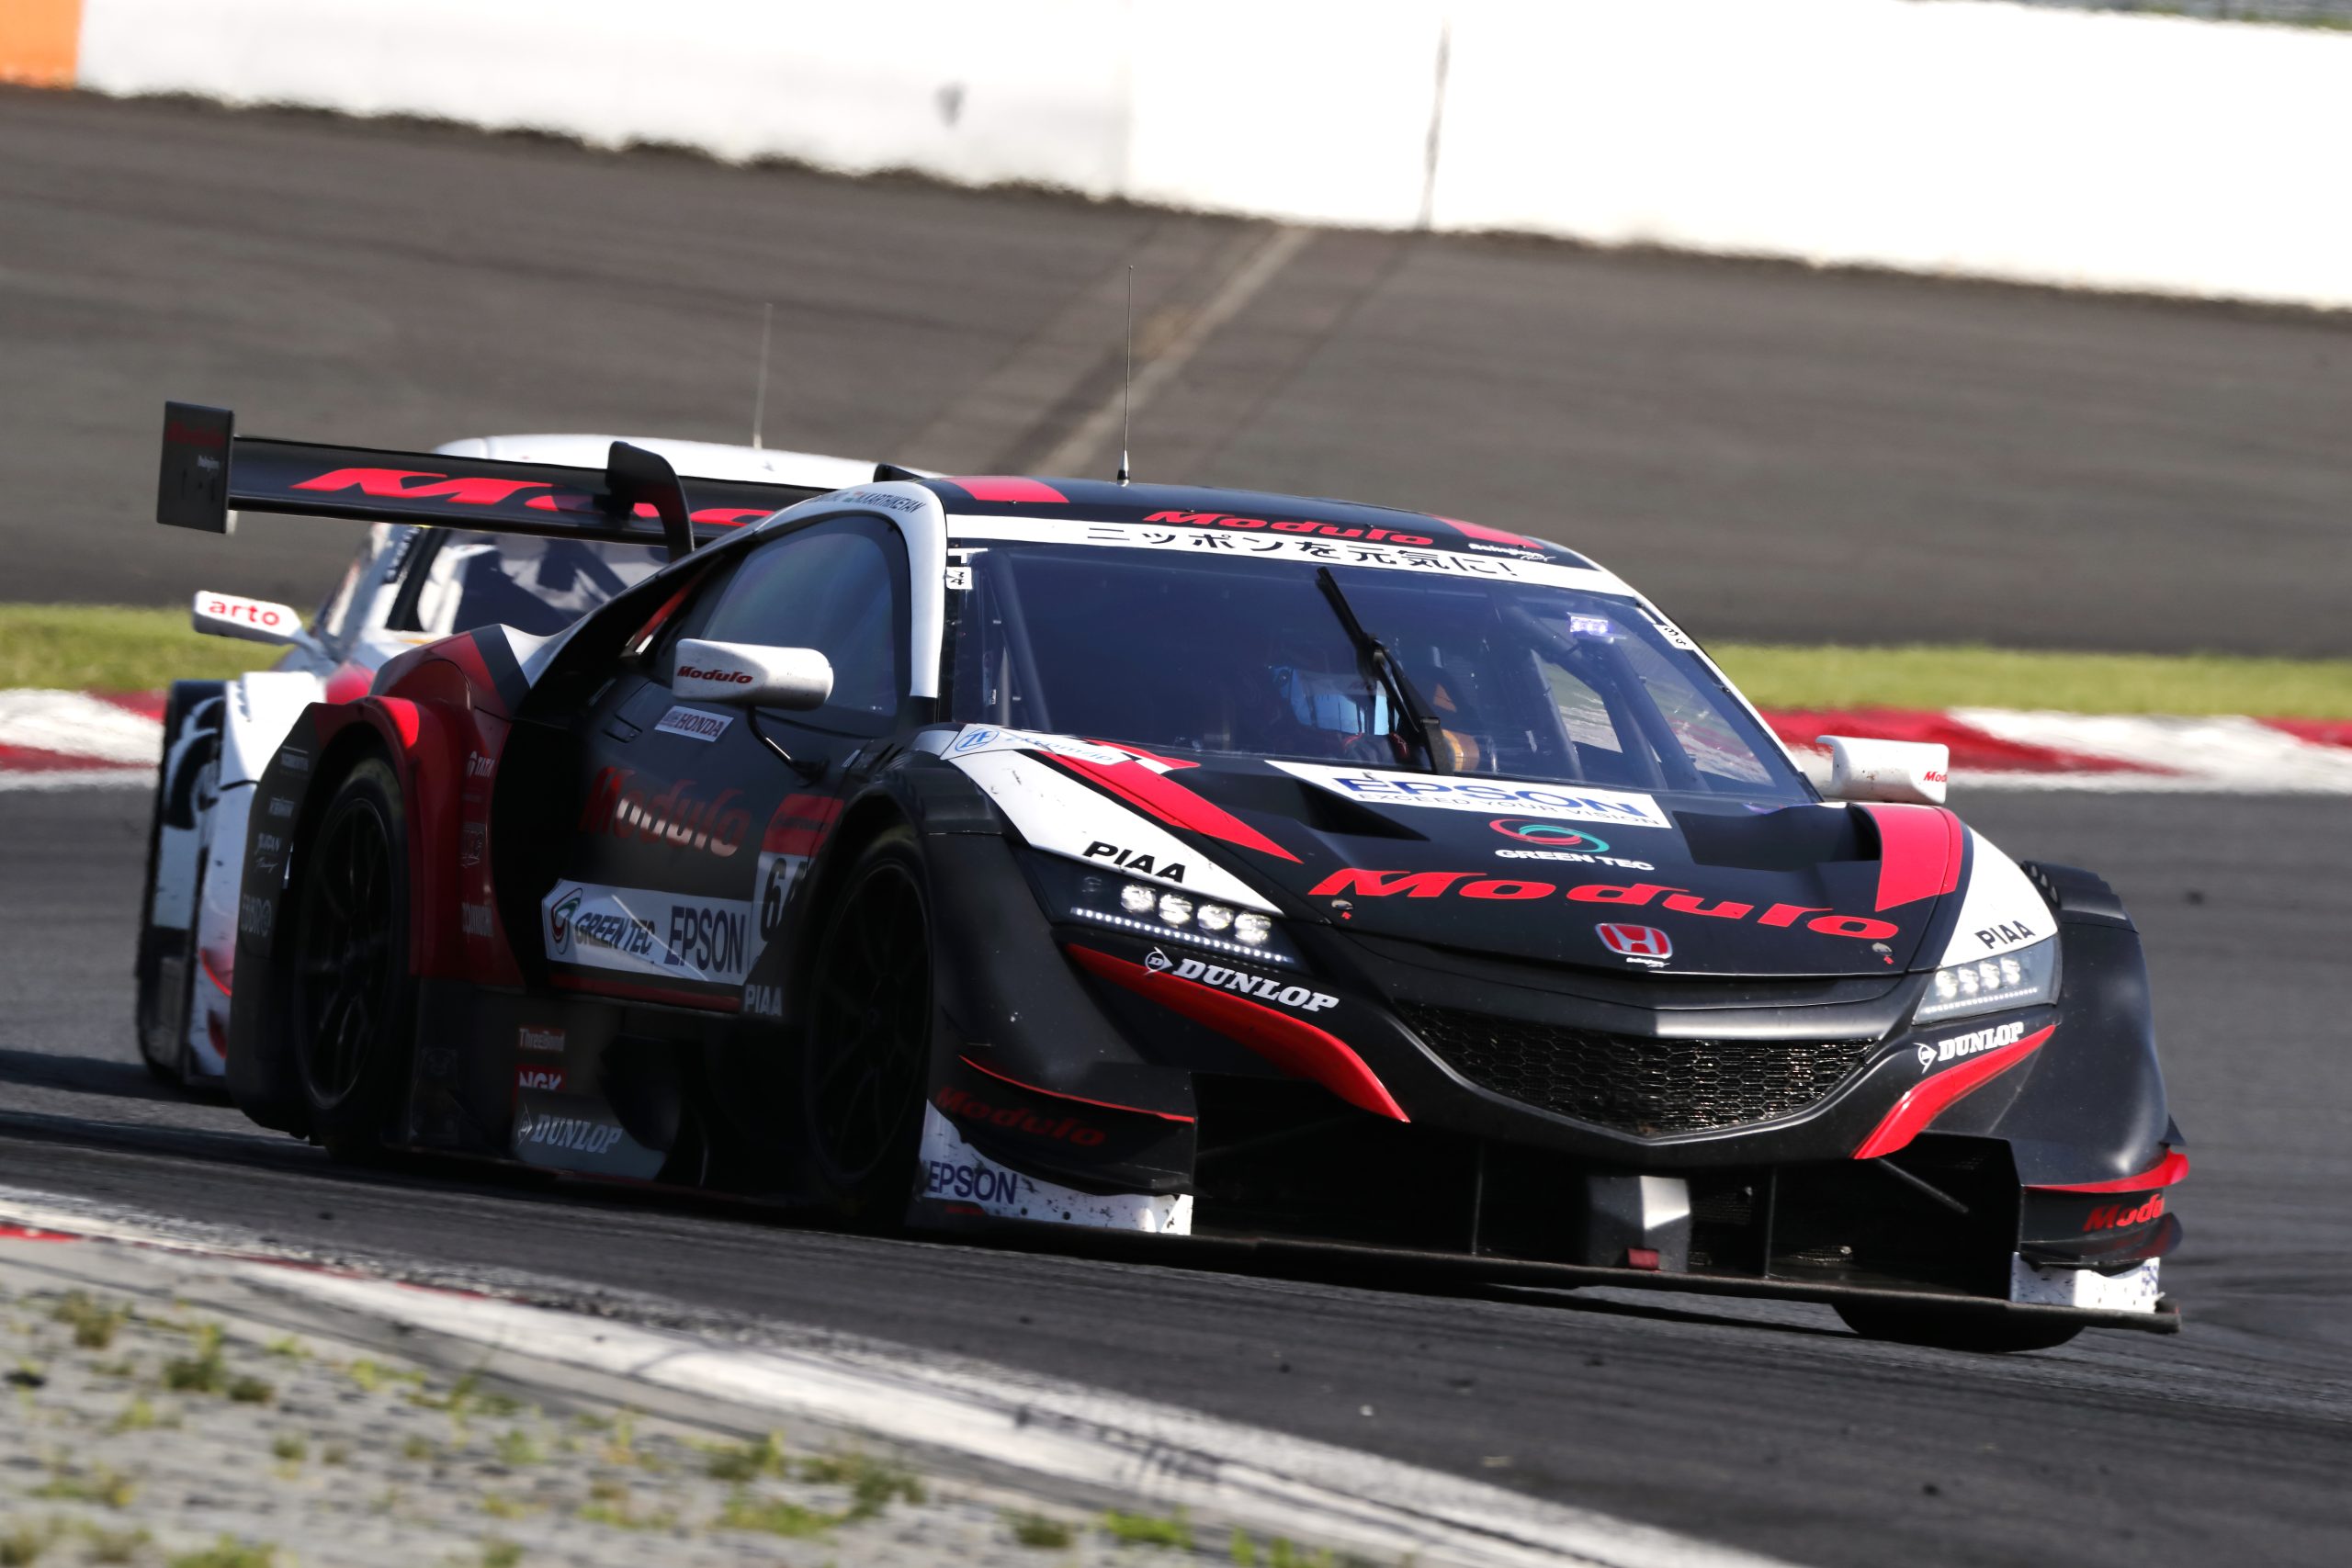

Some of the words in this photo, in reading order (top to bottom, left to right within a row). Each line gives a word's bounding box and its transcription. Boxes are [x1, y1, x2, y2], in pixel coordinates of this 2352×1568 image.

[1142, 511, 1434, 546] Modulo
[1087, 527, 1515, 577] ニッポンを元気に!
[209, 599, 280, 626] arto
[676, 665, 753, 684] Modulo
[675, 713, 725, 738] HONDA
[577, 766, 752, 858] Modulo
[1335, 777, 1648, 818] EPSON
[1358, 793, 1467, 806] EXCEED
[1478, 801, 1559, 813] YOUR
[1566, 809, 1659, 826] VISION
[1082, 840, 1187, 884] PIAA
[1495, 849, 1597, 863] GREEN
[1597, 856, 1656, 871] TEC
[1307, 867, 1899, 940] Modulo
[574, 912, 627, 950] GREEN
[663, 905, 746, 975] EPSON
[1973, 920, 2037, 950] PIAA
[743, 984, 784, 1017] PIAA
[1172, 958, 1340, 1012] DUNLOP
[1938, 1021, 2025, 1062] DUNLOP
[518, 1070, 563, 1091] NGK
[529, 1113, 624, 1155] DUNLOP
[935, 1087, 1109, 1146] Modulo
[927, 1161, 1018, 1205] EPSON
